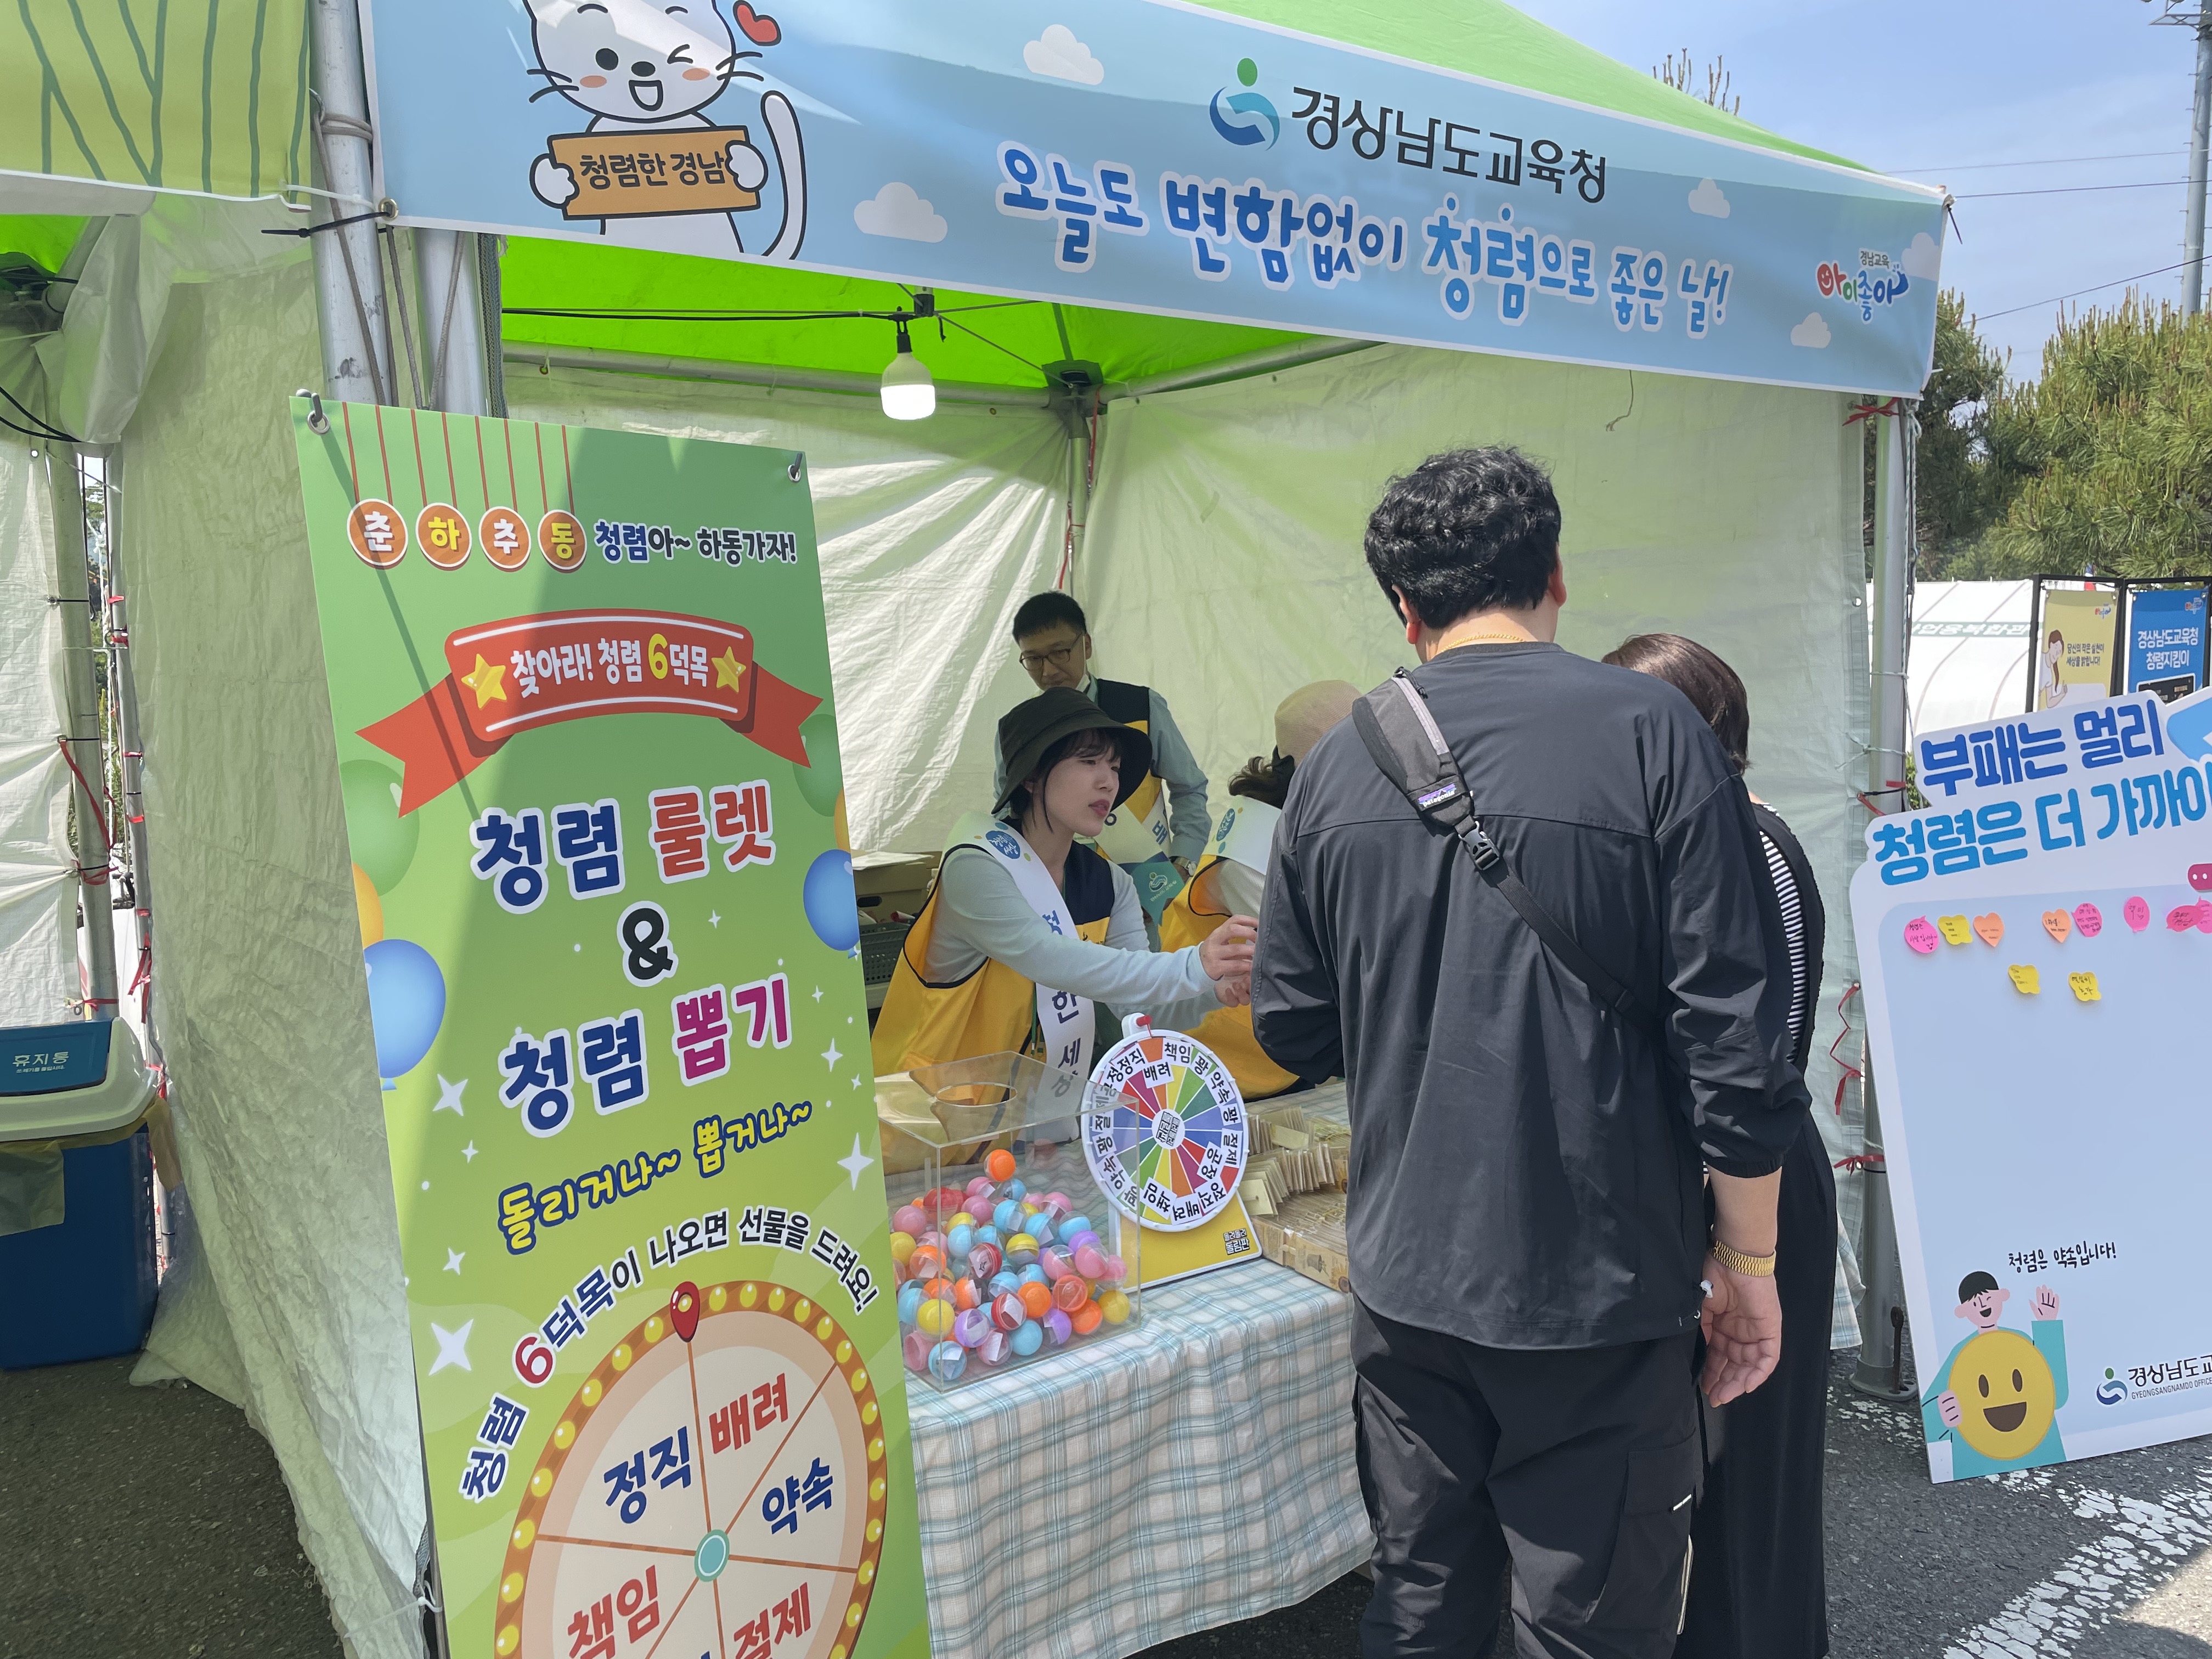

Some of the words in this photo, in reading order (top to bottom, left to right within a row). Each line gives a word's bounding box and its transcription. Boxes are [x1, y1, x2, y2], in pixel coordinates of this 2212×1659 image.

[1292, 86, 1606, 204] 경상남도교육청
[580, 153, 668, 189] 청렴한
[671, 151, 726, 185] 경남
[1003, 149, 1144, 264] 오늘도
[1166, 179, 1403, 283] 변함없이
[1427, 197, 1594, 319] 청렴으로
[1611, 253, 1663, 325] 좋은
[1681, 264, 1729, 333] 날!
[1860, 251, 1889, 269] 경남교육
[1816, 263, 1909, 321] 아이좋아
[363, 511, 395, 553] 춘
[427, 516, 461, 551] 하
[492, 517, 520, 555] 추
[550, 521, 575, 560] 동
[595, 521, 691, 562] 청렴아~
[697, 527, 798, 565] 하동가자!
[2137, 627, 2199, 649] 경상남도교육청
[511, 647, 593, 698] 찾아라!
[599, 638, 642, 685] 청렴
[648, 634, 709, 687] 6덕목
[2146, 650, 2190, 670] 청렴지킴이
[1921, 723, 2068, 797] 부패는
[2074, 699, 2165, 769] 멀리
[1872, 801, 2028, 886] 청렴은
[2035, 788, 2086, 851] 더
[2091, 761, 2212, 840] 가까이
[476, 805, 620, 907] 청렴
[653, 785, 772, 878] 룰렛
[622, 907, 674, 980] &
[12, 1051, 70, 1067] 휴지통
[504, 1015, 647, 1131] 청렴
[676, 979, 788, 1080] 뽑기
[1116, 1048, 1146, 1075] 정직
[1164, 1042, 1191, 1064] 책임
[1194, 1055, 1209, 1076] 꽝
[1144, 1061, 1171, 1081] 배려
[1210, 1071, 1230, 1104] 약속
[1223, 1106, 1239, 1123] 꽝
[1096, 1136, 1113, 1154] 꽝
[1223, 1132, 1239, 1165] 절제
[500, 1149, 680, 1253] 돌리거나~
[695, 1102, 811, 1177] 뽑거나~
[1103, 1155, 1125, 1190] 약속
[1201, 1148, 1222, 1180] 공정
[1143, 1182, 1171, 1212] 책임
[1172, 1200, 1200, 1221] 배려
[1198, 1182, 1226, 1209] 정직
[1225, 1238, 1250, 1255] 돌림판
[2008, 1249, 2048, 1273] 청렴은
[2053, 1240, 2117, 1268] 약속입니다!
[462, 1396, 527, 1499] 청렴
[515, 1251, 641, 1385] 6덕목이
[650, 1210, 729, 1266] 나오면
[739, 1208, 809, 1250] 선물을
[811, 1231, 878, 1313] 드려요!
[2131, 1381, 2193, 1400] GYEONGSANGNAMDO
[708, 1373, 789, 1455] 배려
[603, 1426, 691, 1525] 정직
[762, 1457, 834, 1535] 약속
[568, 1565, 660, 1659] 책임
